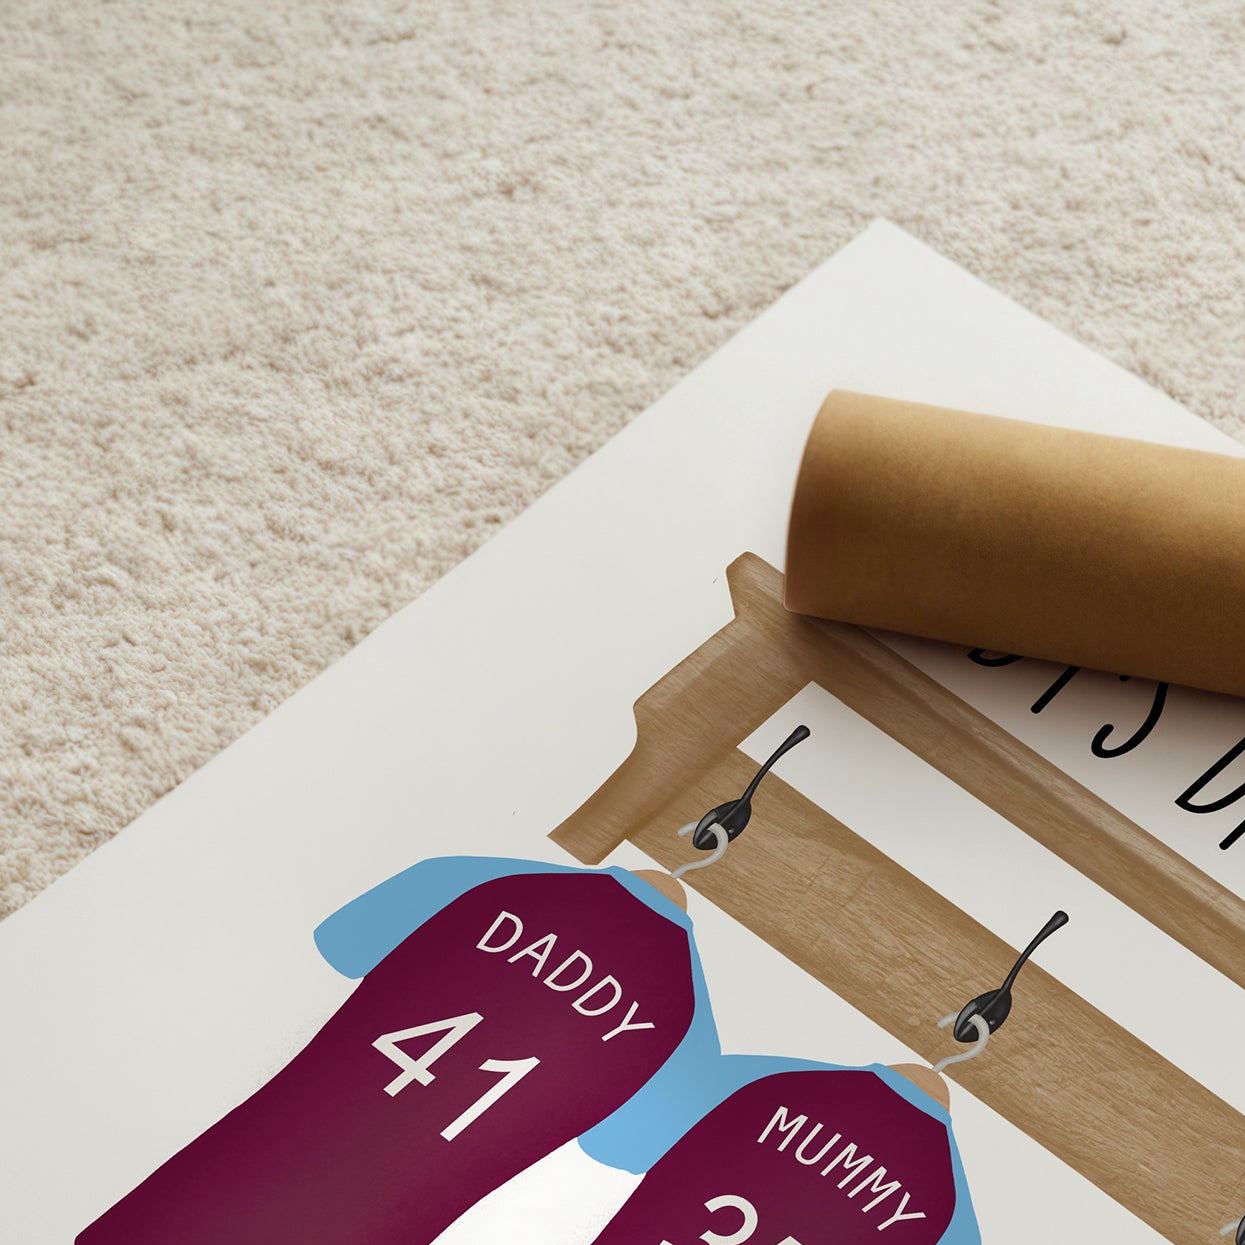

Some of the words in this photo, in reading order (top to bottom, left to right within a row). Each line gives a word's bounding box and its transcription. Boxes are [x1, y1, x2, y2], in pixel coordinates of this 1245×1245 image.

[476, 910, 655, 1042] DADDY
[371, 1011, 541, 1142] 41
[757, 1106, 926, 1232] MUMMY
